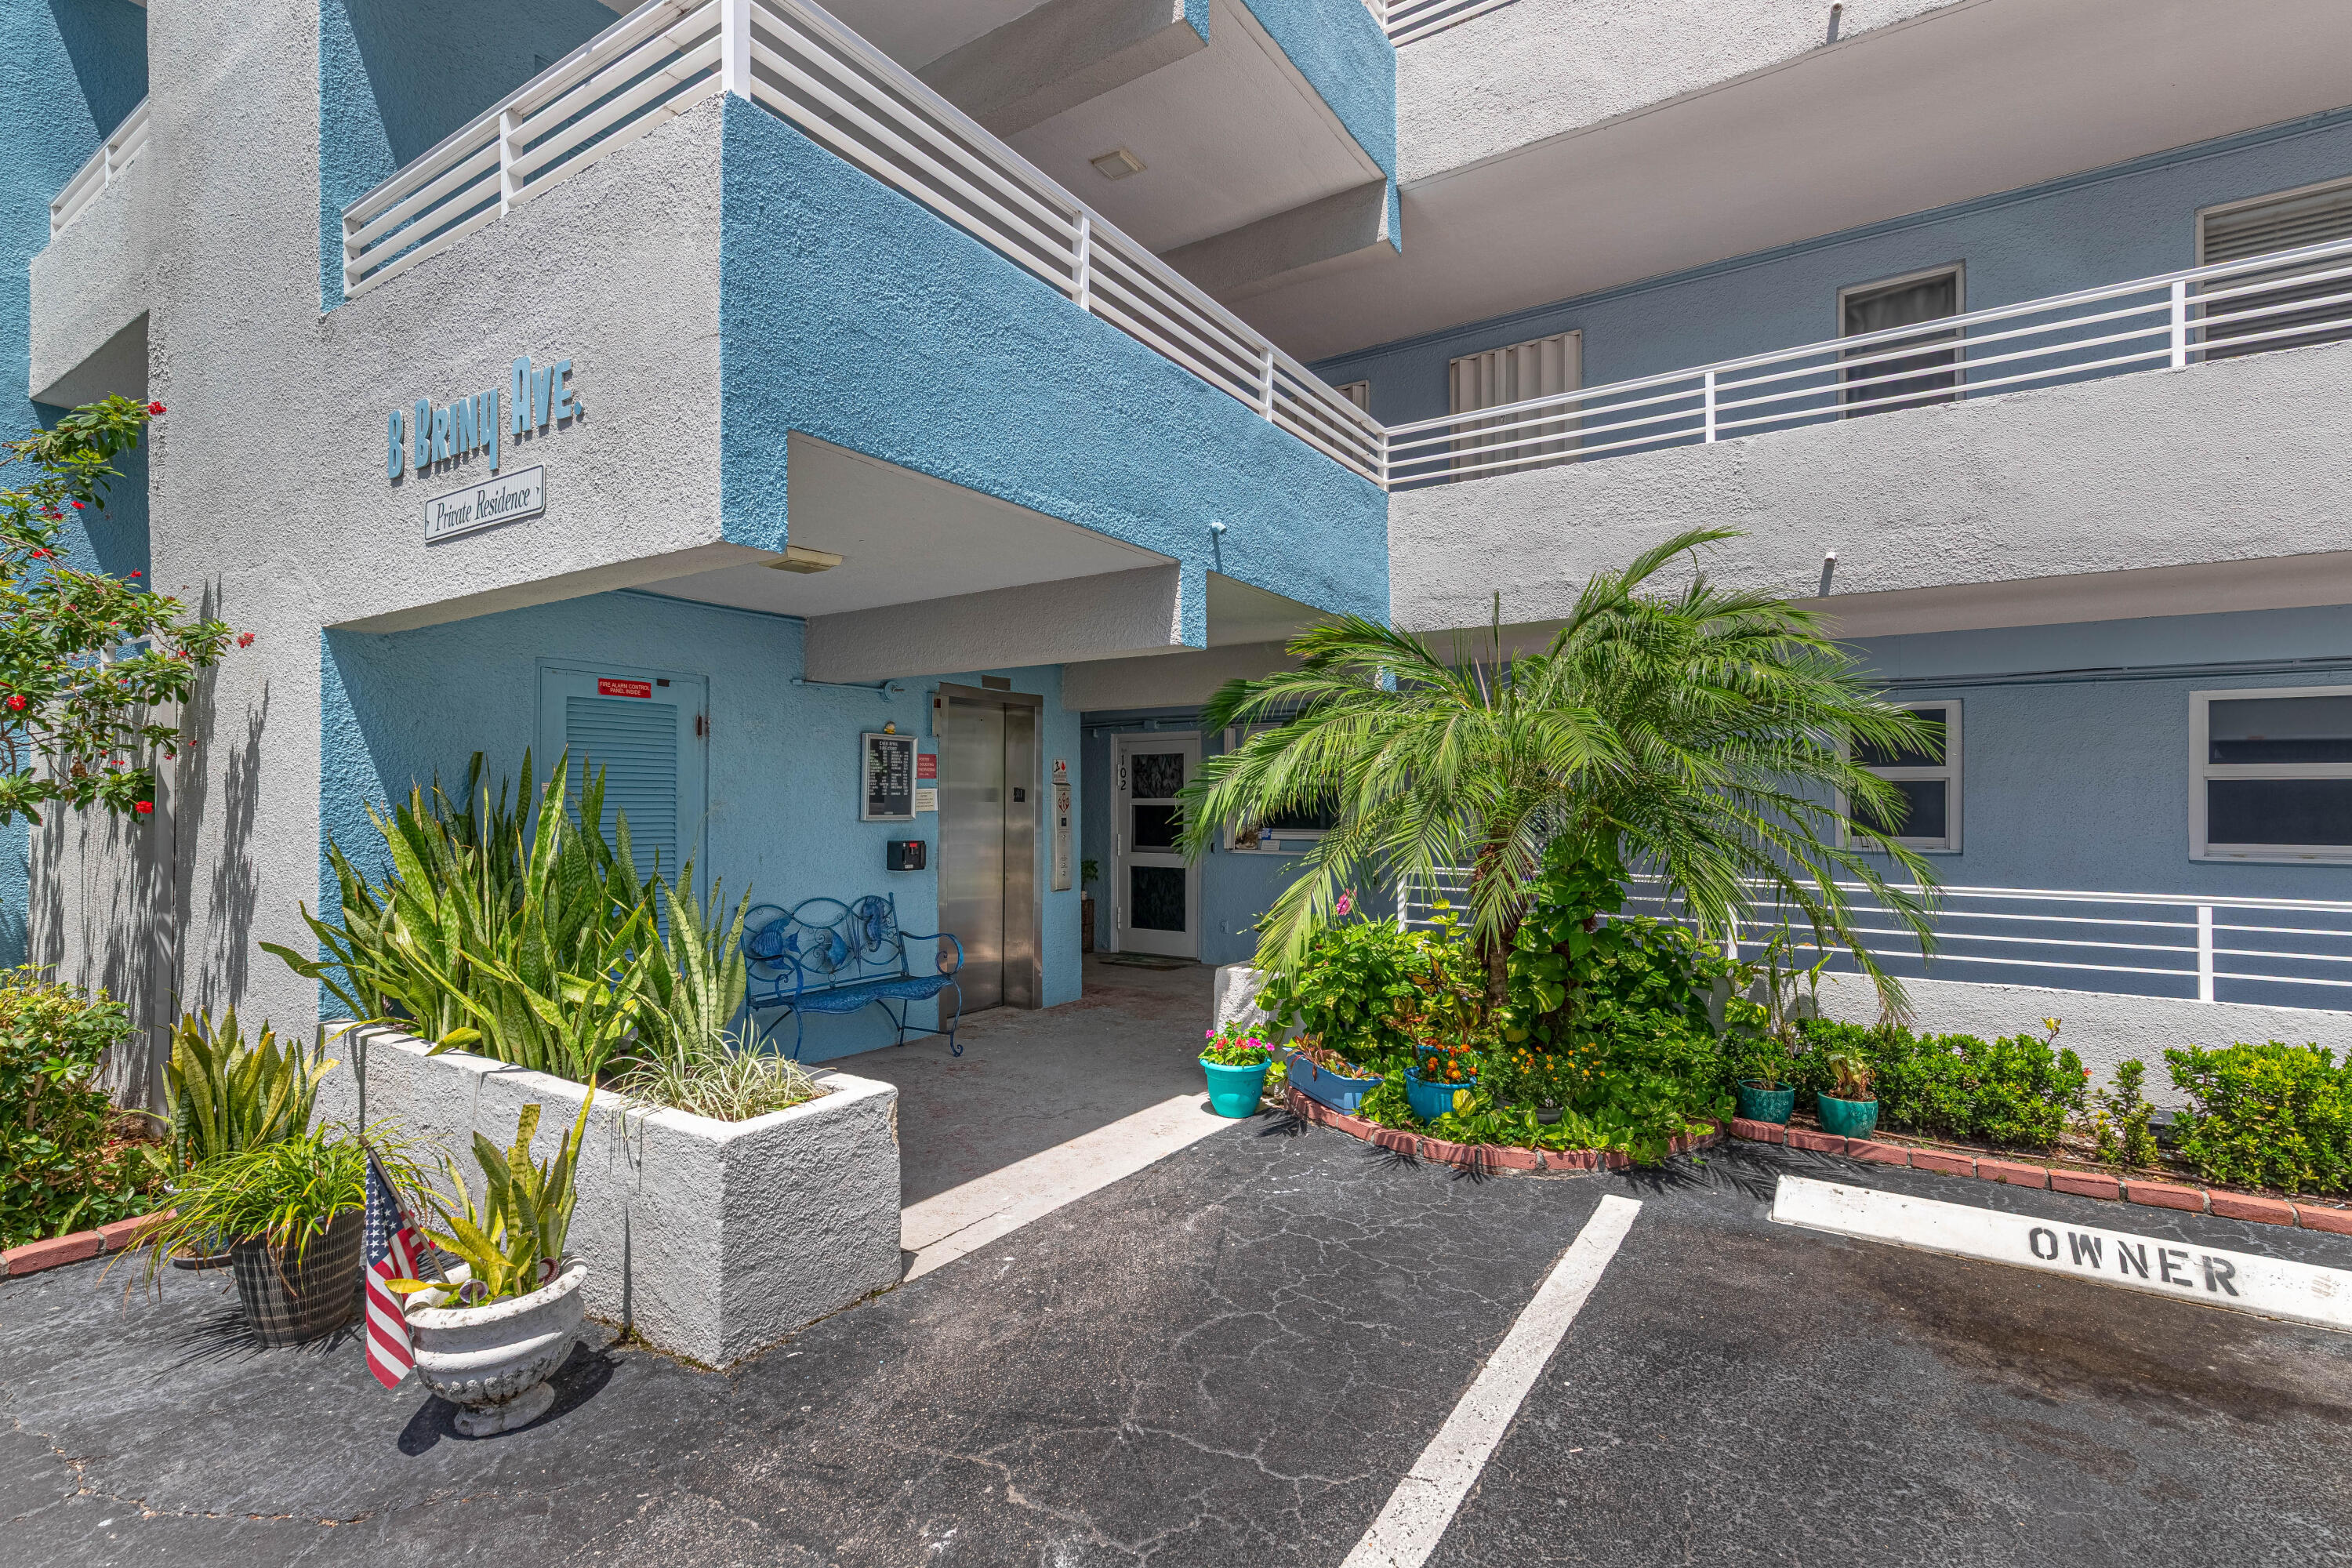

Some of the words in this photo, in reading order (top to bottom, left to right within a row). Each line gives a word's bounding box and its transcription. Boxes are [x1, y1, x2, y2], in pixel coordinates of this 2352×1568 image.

[388, 409, 404, 479] 8
[511, 356, 583, 435] AVE.
[435, 502, 472, 531] Private
[474, 486, 531, 521] Residence
[2028, 1227, 2239, 1296] OWNER
